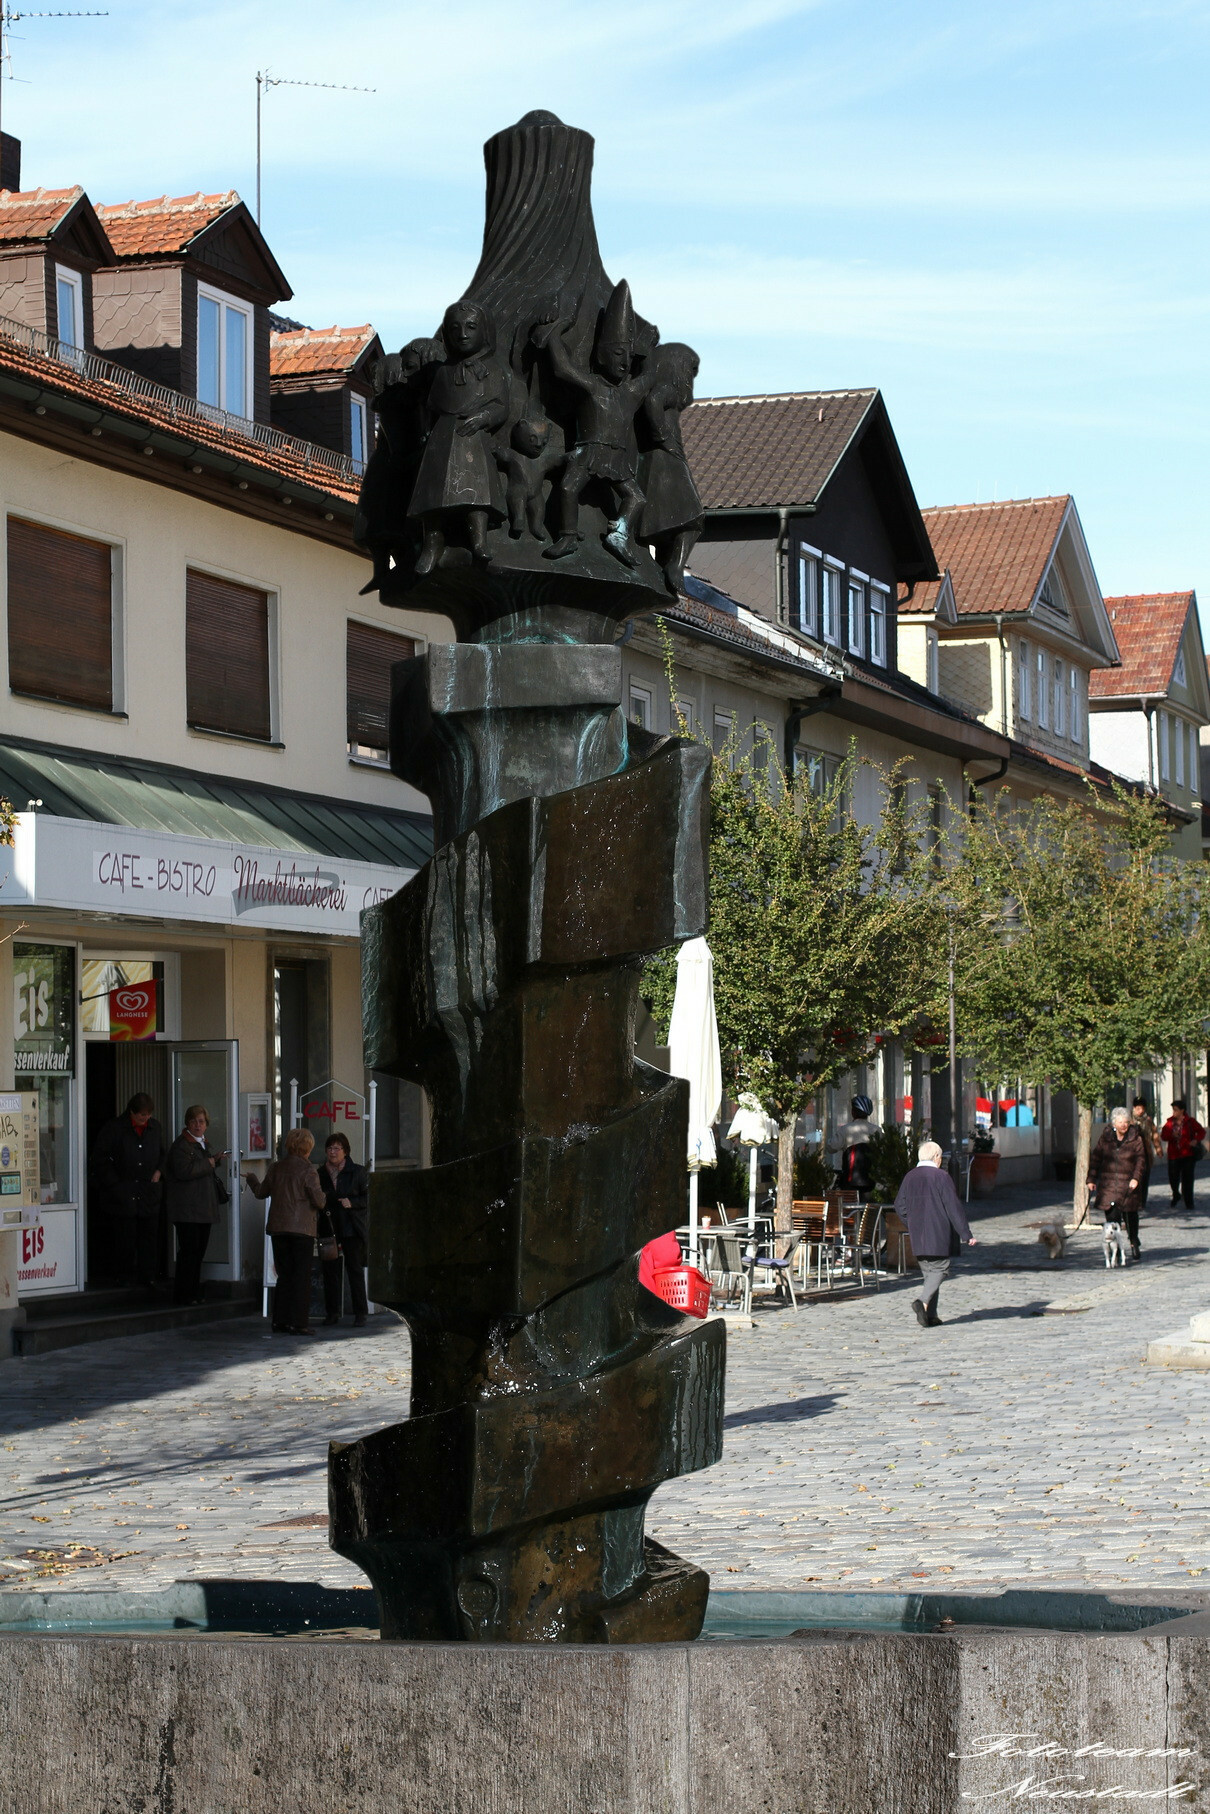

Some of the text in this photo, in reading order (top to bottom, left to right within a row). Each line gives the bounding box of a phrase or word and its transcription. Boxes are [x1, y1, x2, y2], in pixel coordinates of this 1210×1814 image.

[234, 855, 348, 911] Marktbäckerei
[13, 966, 49, 1041] Eis
[304, 1101, 361, 1123] CAFE
